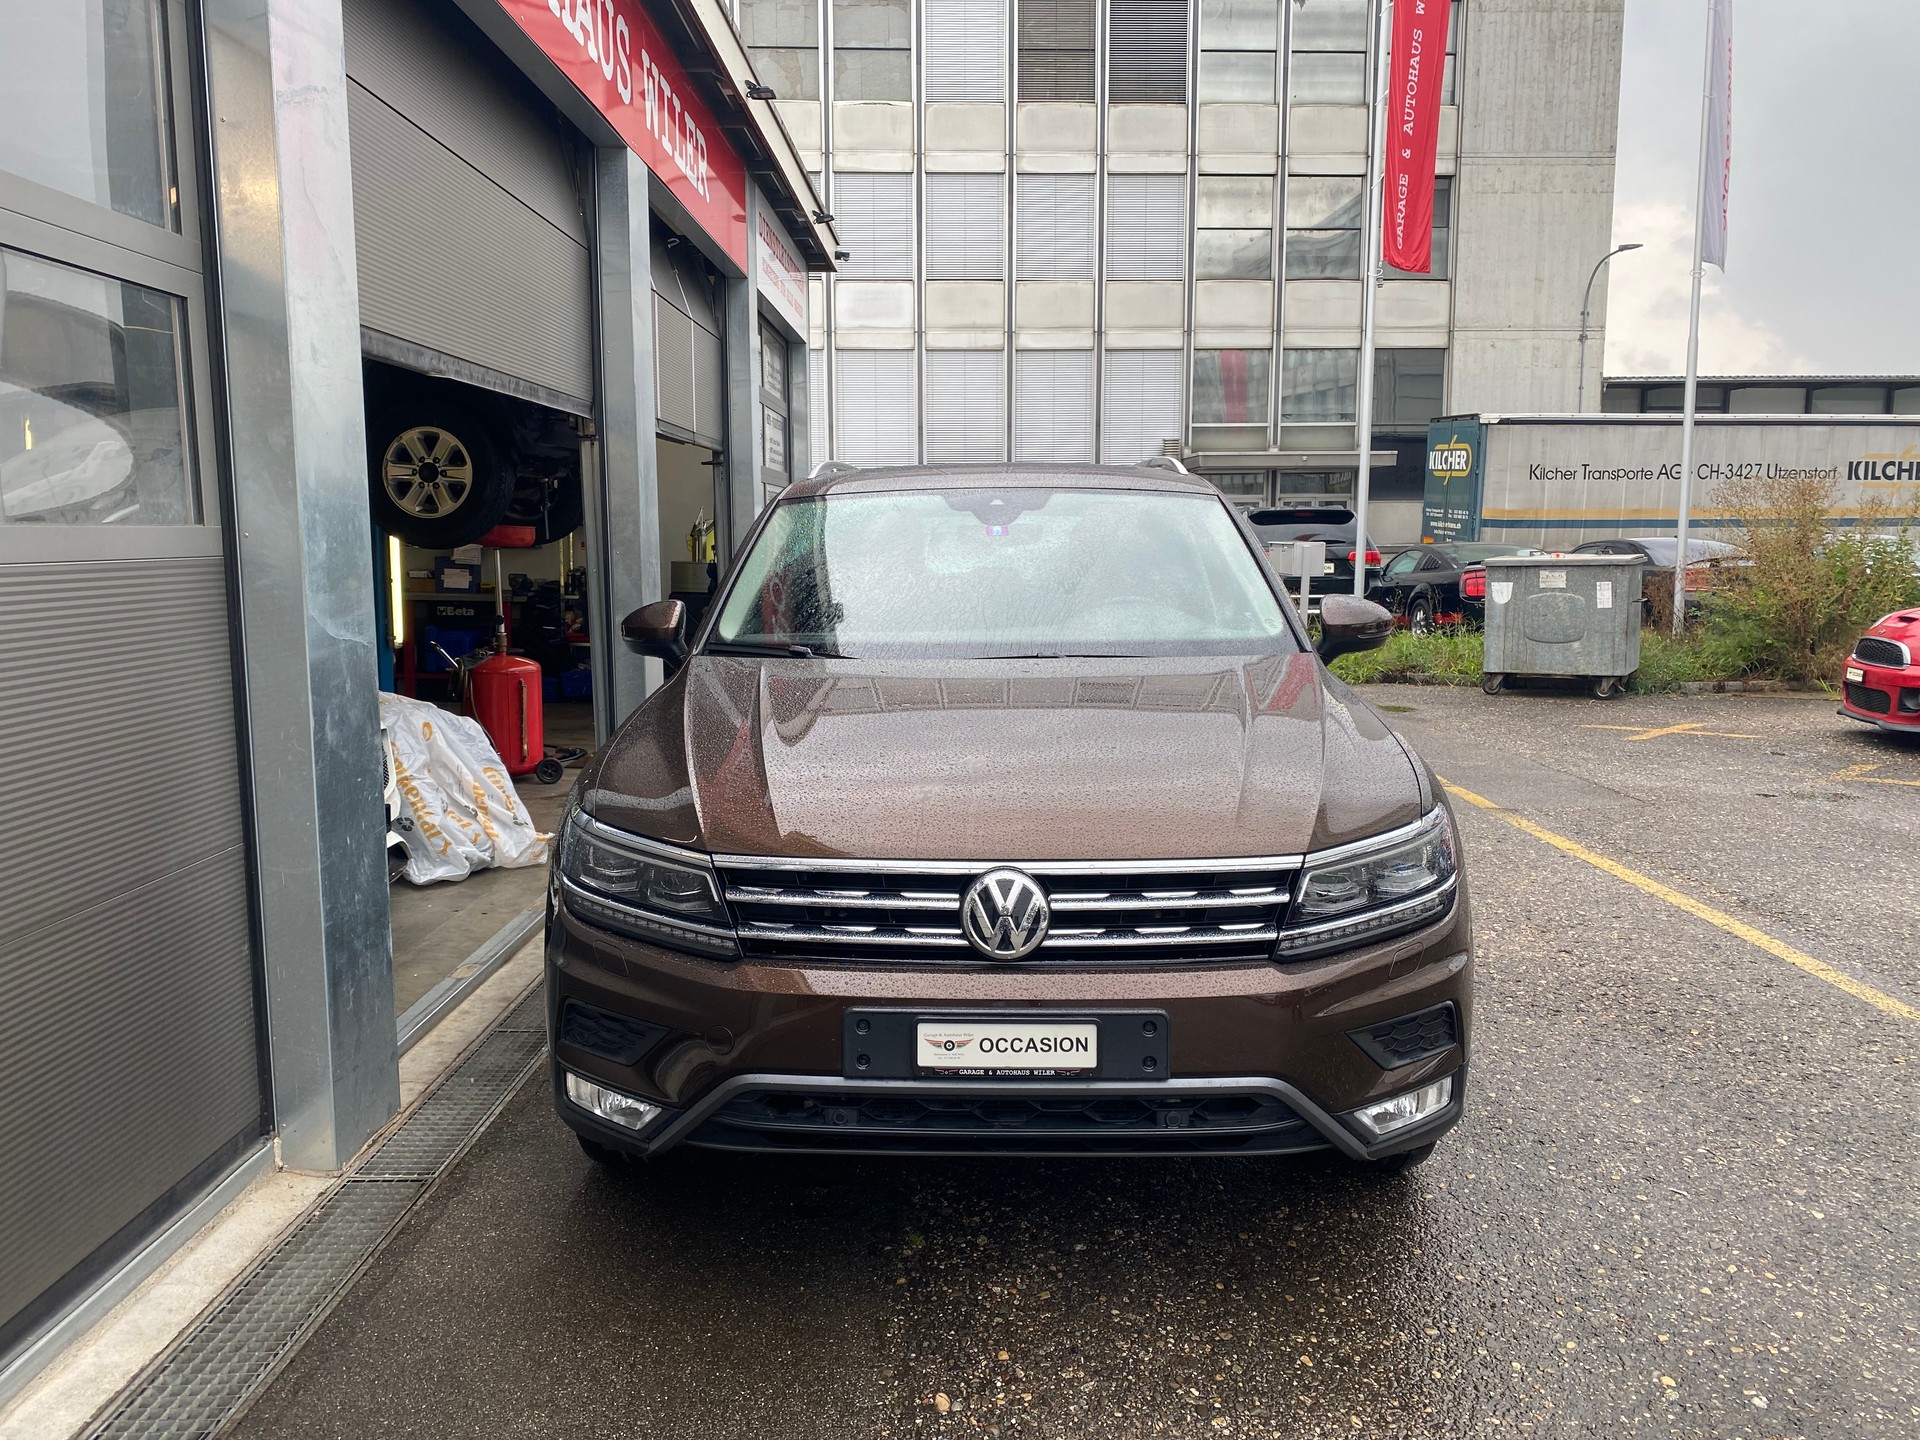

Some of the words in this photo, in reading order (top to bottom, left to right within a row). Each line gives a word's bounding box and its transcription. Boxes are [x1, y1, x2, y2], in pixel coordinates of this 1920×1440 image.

[1403, 28, 1423, 136] AUTOHAUS
[641, 48, 710, 204] WILER
[1401, 148, 1411, 159] &
[1396, 173, 1409, 250] GARAGE
[1429, 450, 1467, 470] KILCHER
[1529, 463, 1578, 480] Kilcher
[1581, 463, 1653, 482] Transporte
[1656, 463, 1682, 480] AG
[1697, 463, 1763, 480] CH-3427
[1766, 463, 1838, 480] Utzenstorf
[447, 606, 475, 616] Beta
[979, 1037, 1089, 1053] OCCASION
